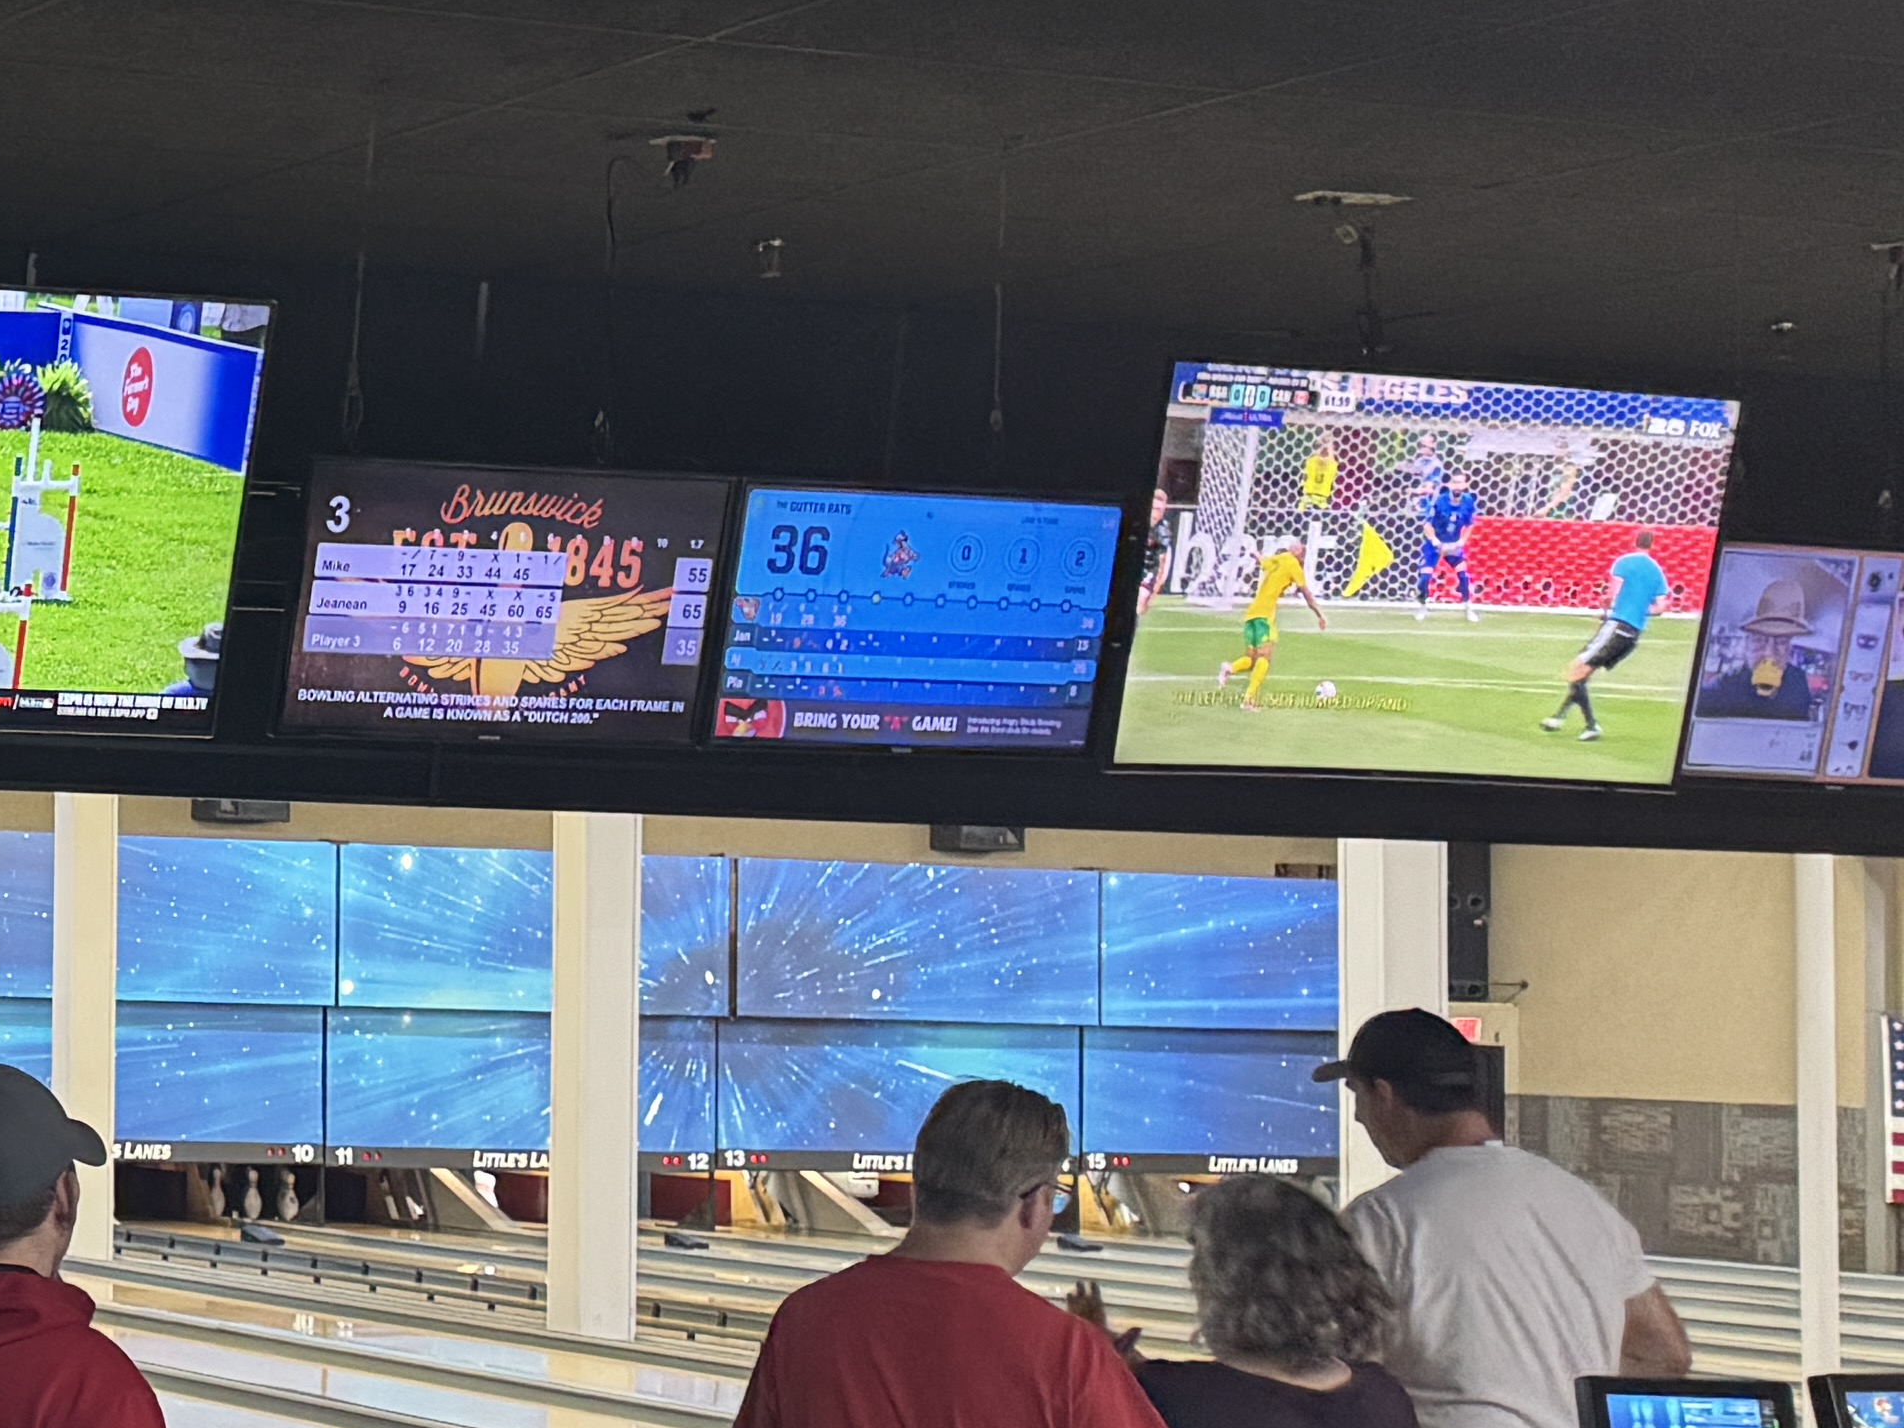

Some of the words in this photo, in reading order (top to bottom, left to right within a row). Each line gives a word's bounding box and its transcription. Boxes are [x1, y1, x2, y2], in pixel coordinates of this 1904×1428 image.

[1689, 419, 1723, 440] FOX
[325, 495, 351, 533] 3
[440, 483, 604, 530] Brunswick
[766, 524, 831, 576] 36
[321, 560, 351, 573] Mike
[687, 567, 708, 583] 55
[682, 604, 702, 620] 65
[311, 634, 350, 648] Player
[676, 639, 697, 656] 35
[297, 688, 356, 703] BOWLING
[356, 690, 439, 705] ALTERNATING
[440, 692, 491, 707] STRIKES
[492, 694, 518, 708] AND
[519, 695, 567, 710] SPARES
[568, 697, 593, 711] FOR
[594, 698, 629, 712] EACH
[629, 699, 670, 713] FRAME
[671, 700, 685, 714] IN
[382, 705, 393, 719] A
[394, 706, 431, 720] GAME
[432, 707, 445, 720] IS
[445, 707, 492, 722] KNOWN
[492, 709, 511, 722] AS
[511, 710, 521, 722] A
[793, 711, 837, 729] BRING
[842, 713, 881, 730] YOUR
[911, 715, 958, 732] GAME!
[123, 1141, 172, 1161] LANES
[291, 1143, 315, 1163] 10
[334, 1146, 354, 1166] 11
[472, 1149, 529, 1170] LITTLE'S
[724, 1149, 746, 1167] 13
[1086, 1151, 1107, 1170] 15
[687, 1152, 710, 1171] 12
[1208, 1155, 1258, 1173] LITTLE'S
[1258, 1155, 1299, 1174] LANES
